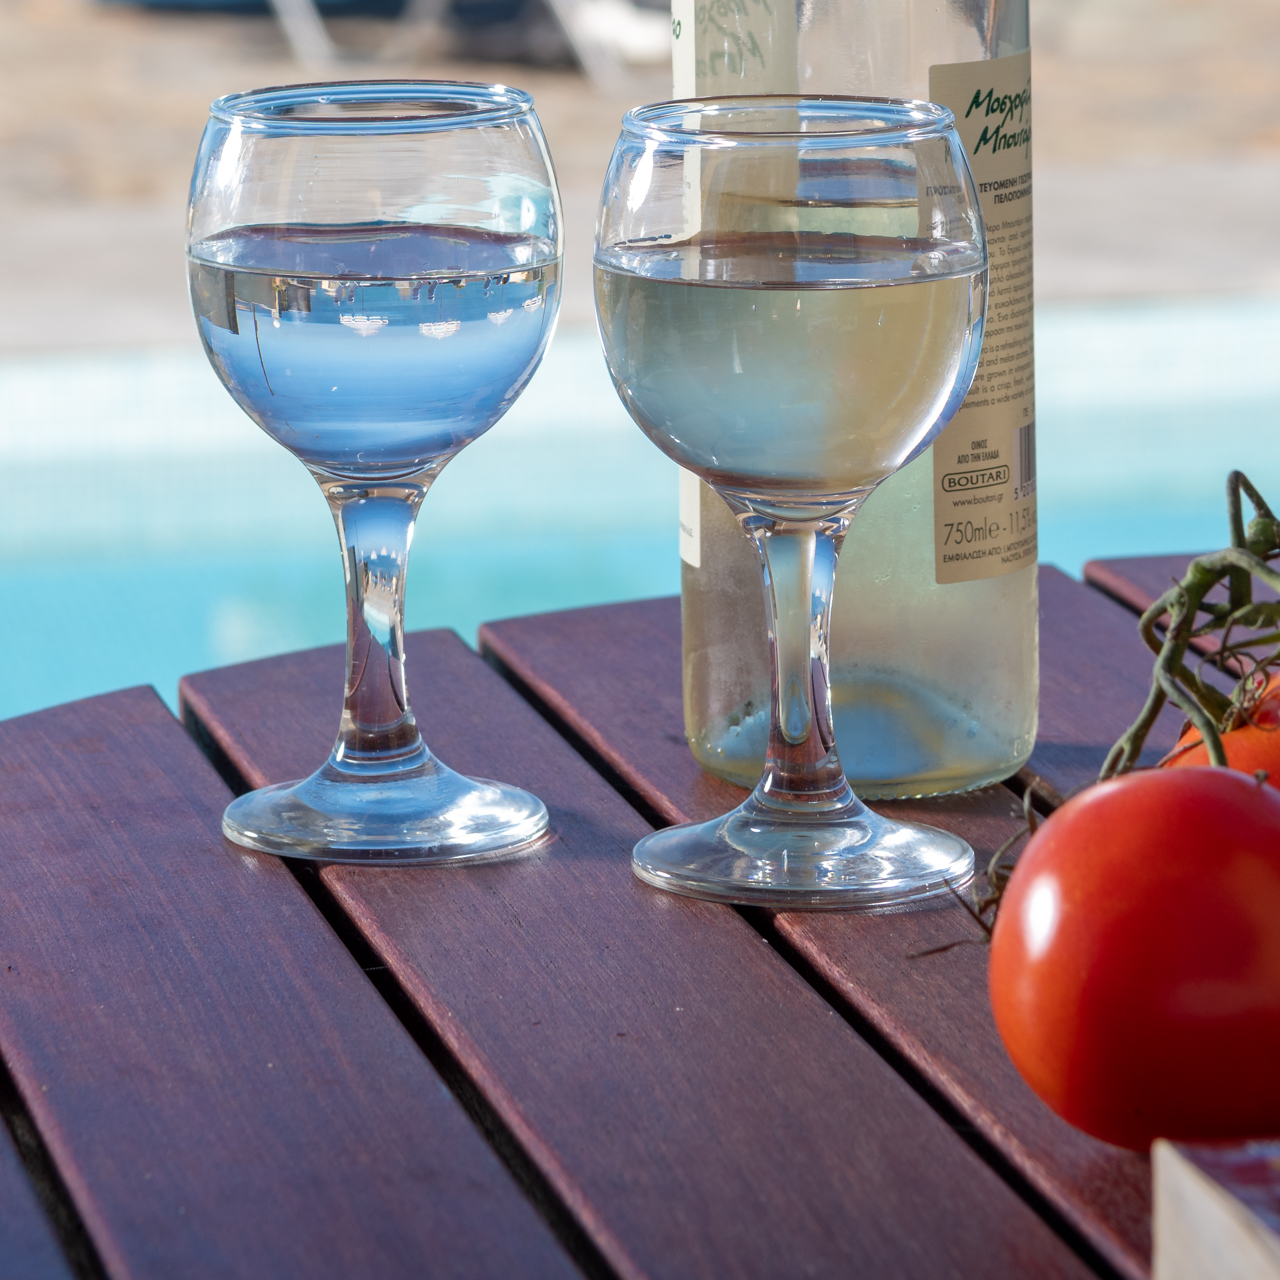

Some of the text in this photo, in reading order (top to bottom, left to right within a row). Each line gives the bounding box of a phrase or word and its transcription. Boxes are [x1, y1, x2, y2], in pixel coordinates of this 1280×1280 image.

[986, 355, 998, 367] and
[1000, 352, 1015, 363] melon
[987, 369, 1006, 382] grown
[967, 384, 979, 395] sult
[959, 398, 989, 412] plements
[996, 391, 1010, 403] wide
[957, 453, 970, 465] ΑΠΟ
[970, 452, 981, 463] ΤΗΝ
[947, 469, 1006, 488] BOUTARI
[952, 492, 1004, 507] www.boutari.gr
[943, 549, 987, 563] ΕΜΦΙΑΛΩΣΗ
